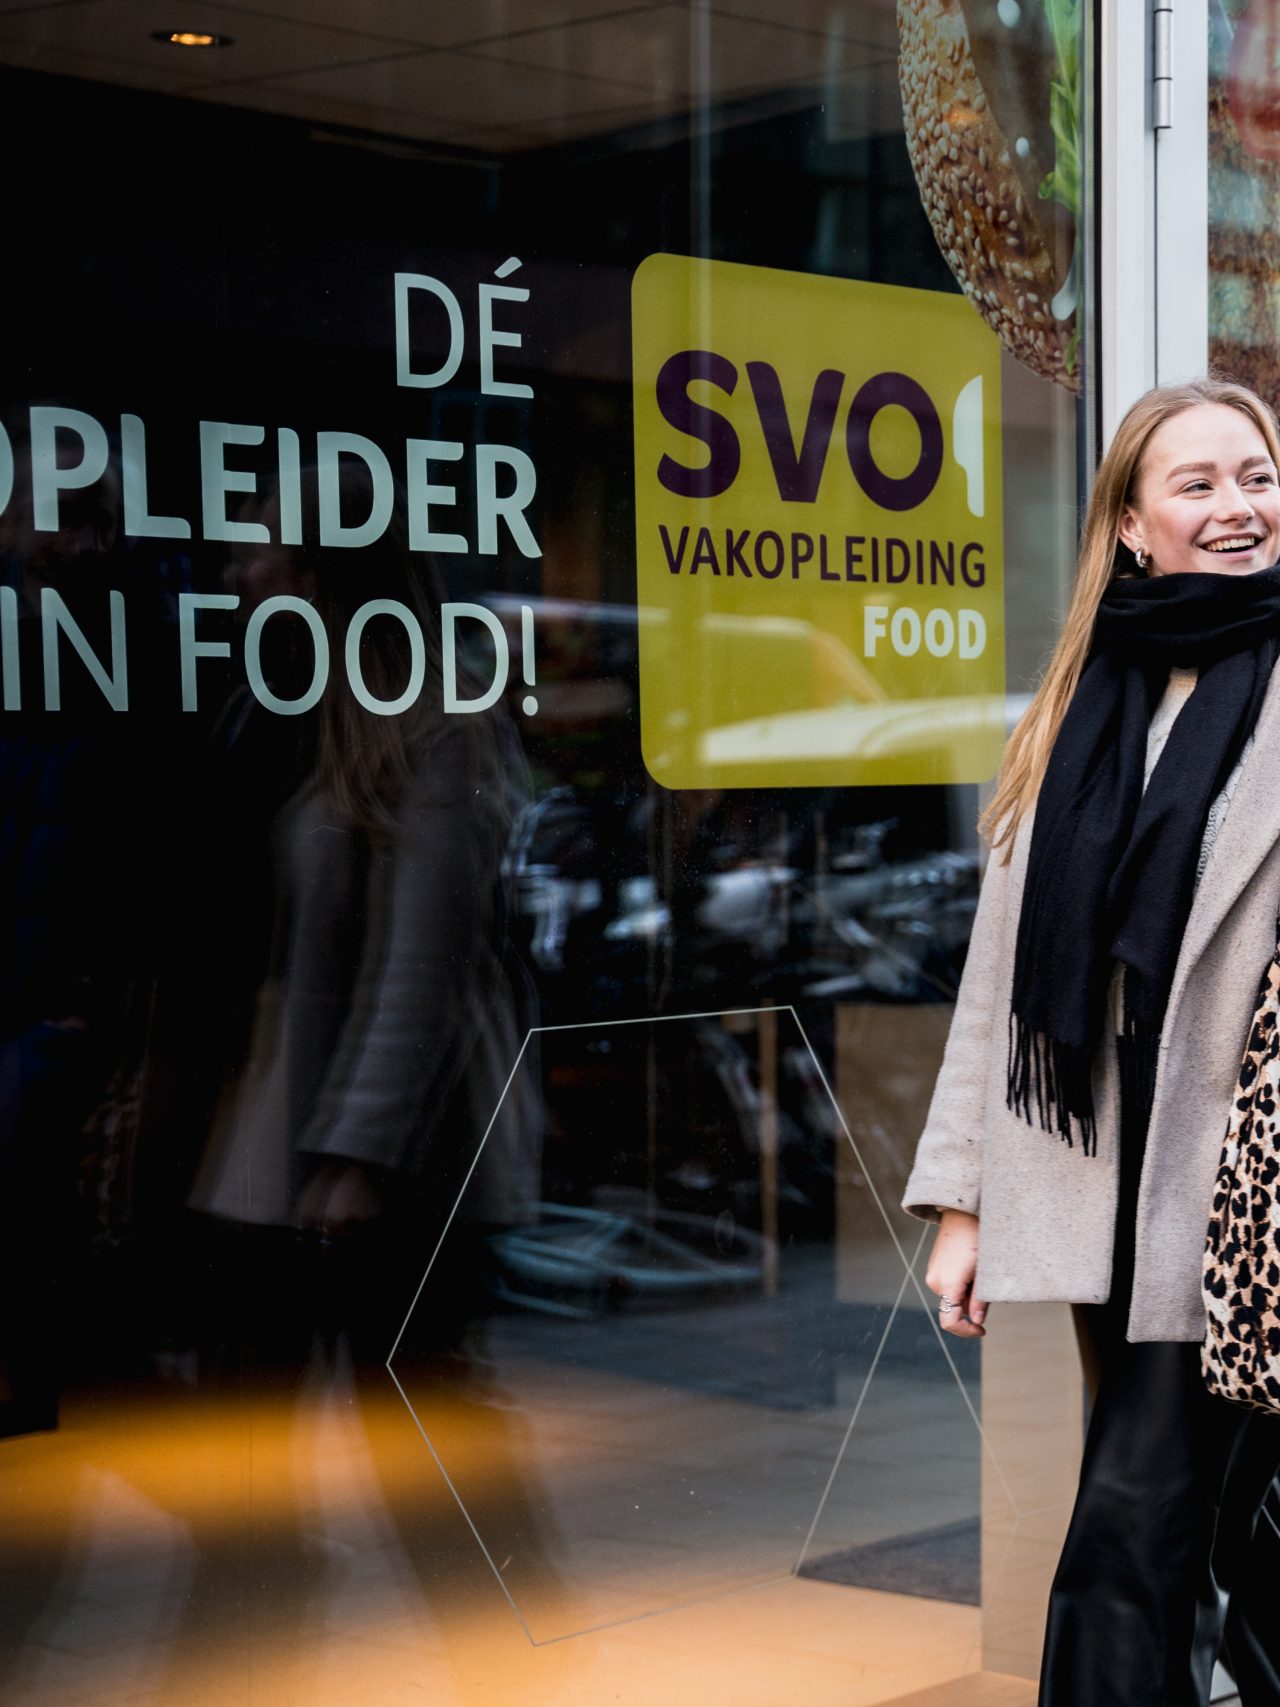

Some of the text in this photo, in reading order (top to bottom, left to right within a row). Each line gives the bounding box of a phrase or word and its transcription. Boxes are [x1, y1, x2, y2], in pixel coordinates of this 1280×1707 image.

[394, 256, 534, 399] DÉ
[0, 406, 543, 559] PLEIDER
[655, 349, 945, 512] SVO
[658, 524, 986, 588] VAKOPLEIDING
[0, 585, 540, 717] IN FOOD!
[864, 606, 986, 659] FOOD
